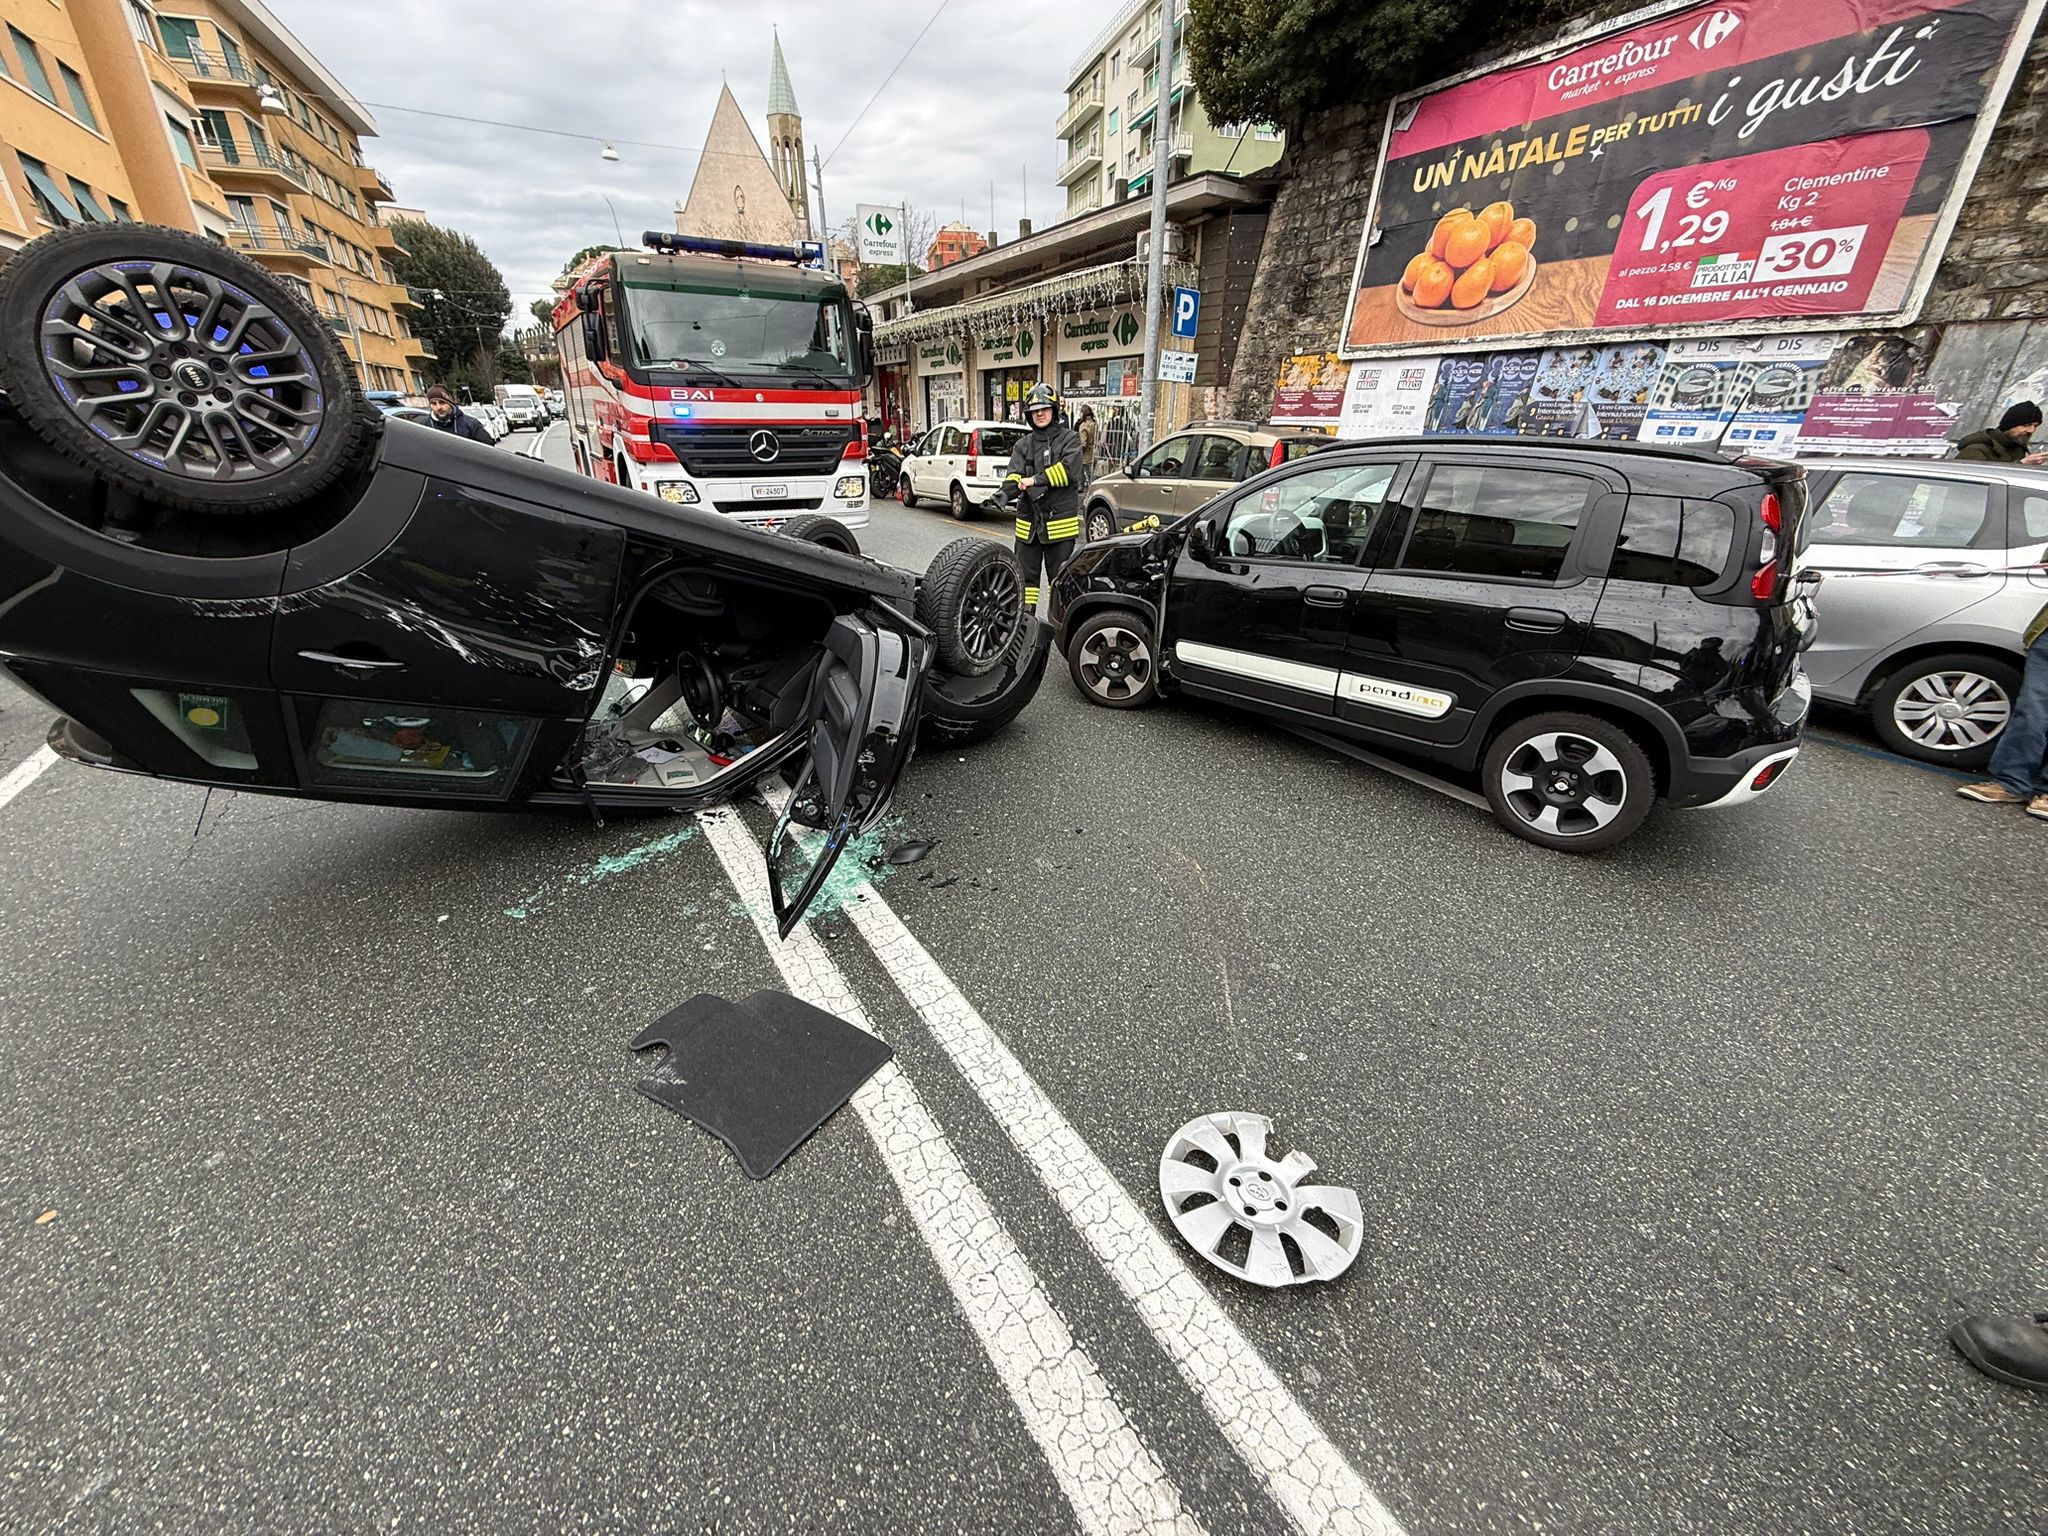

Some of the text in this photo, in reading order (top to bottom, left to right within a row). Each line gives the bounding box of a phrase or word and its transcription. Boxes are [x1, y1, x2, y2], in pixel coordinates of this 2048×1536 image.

[1548, 34, 1679, 91] Carrefour
[1560, 64, 1659, 101] market express
[1413, 25, 1933, 193] UN NATALE PER TUTTI i gusti
[1784, 165, 1889, 192] Clementine
[1777, 191, 1819, 212] Kg 2
[863, 238, 898, 248] Carrefour
[1618, 261, 1692, 277] al pezzo 2,58 €
[1693, 269, 1748, 286] ITALIA
[1697, 261, 1752, 273] PRODOTTO IN
[1616, 298, 1640, 309] DAL
[1643, 296, 1656, 307] 16
[1658, 290, 1732, 306] DICEMBRE
[1771, 281, 1848, 297] GENNAIO
[1177, 293, 1195, 332] P
[1064, 318, 1110, 339] Carrefour
[1697, 340, 1721, 352] DIS
[1777, 339, 1803, 351] DIS
[185, 366, 204, 388] MINI
[670, 389, 714, 401] BAI
[1360, 684, 1444, 708] pandina
